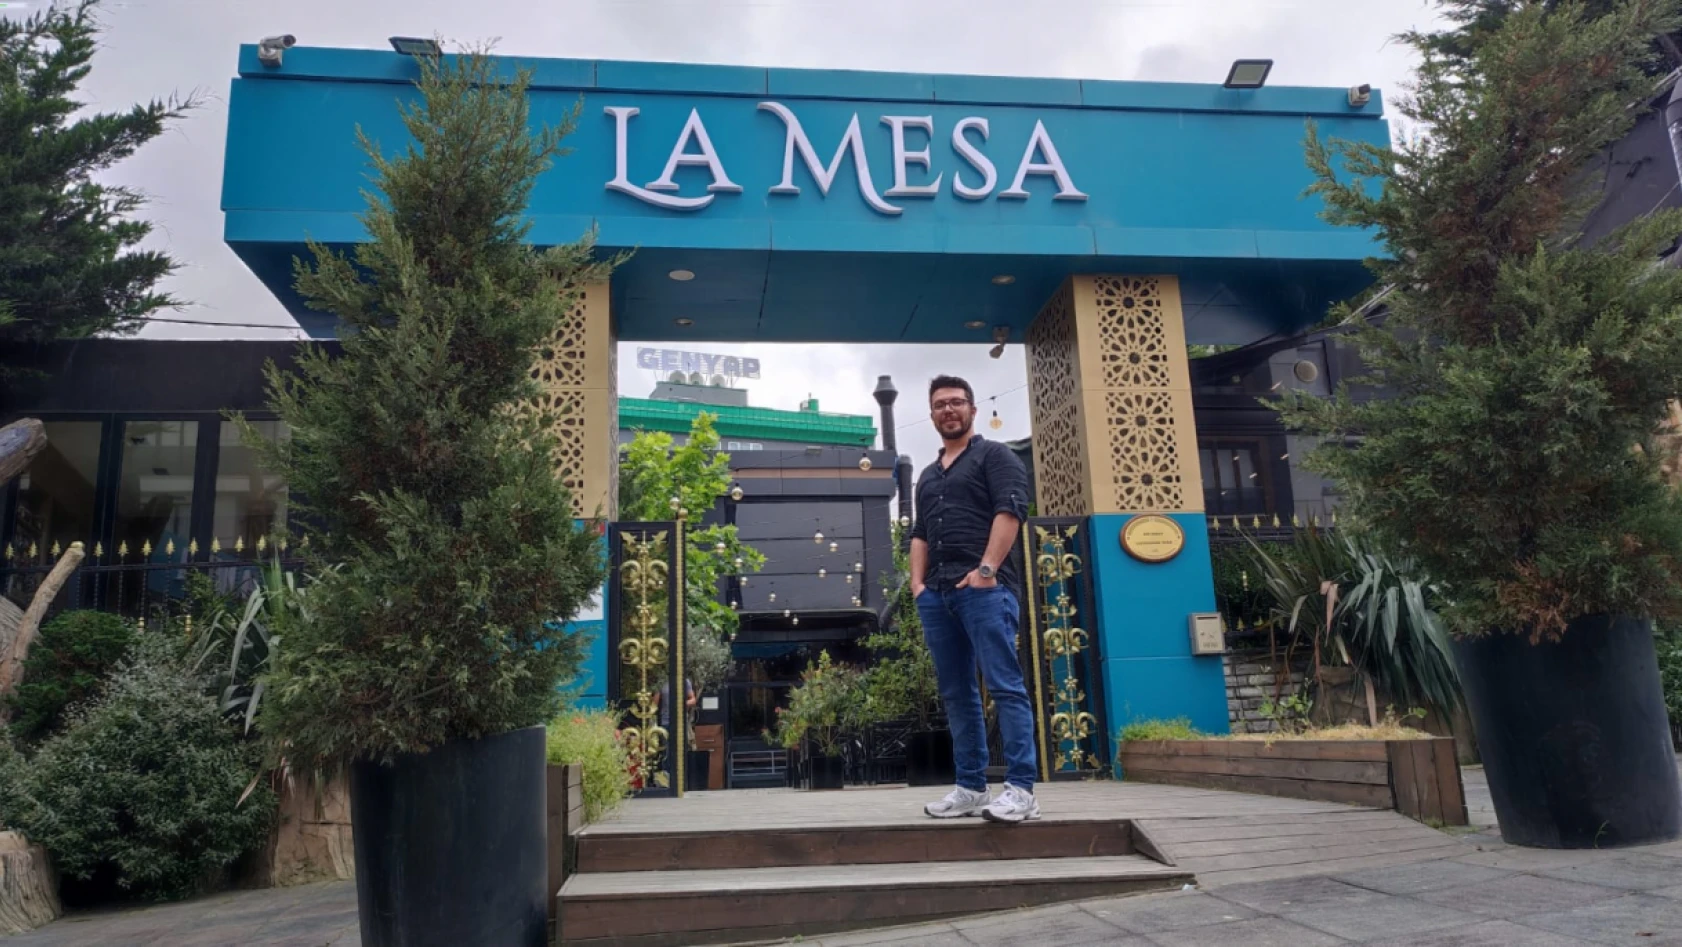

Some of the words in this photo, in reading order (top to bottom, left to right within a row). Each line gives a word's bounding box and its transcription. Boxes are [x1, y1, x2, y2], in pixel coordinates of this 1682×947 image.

[604, 106, 743, 211] LA
[757, 101, 1089, 215] MESA
[637, 347, 760, 379] GENYAP
